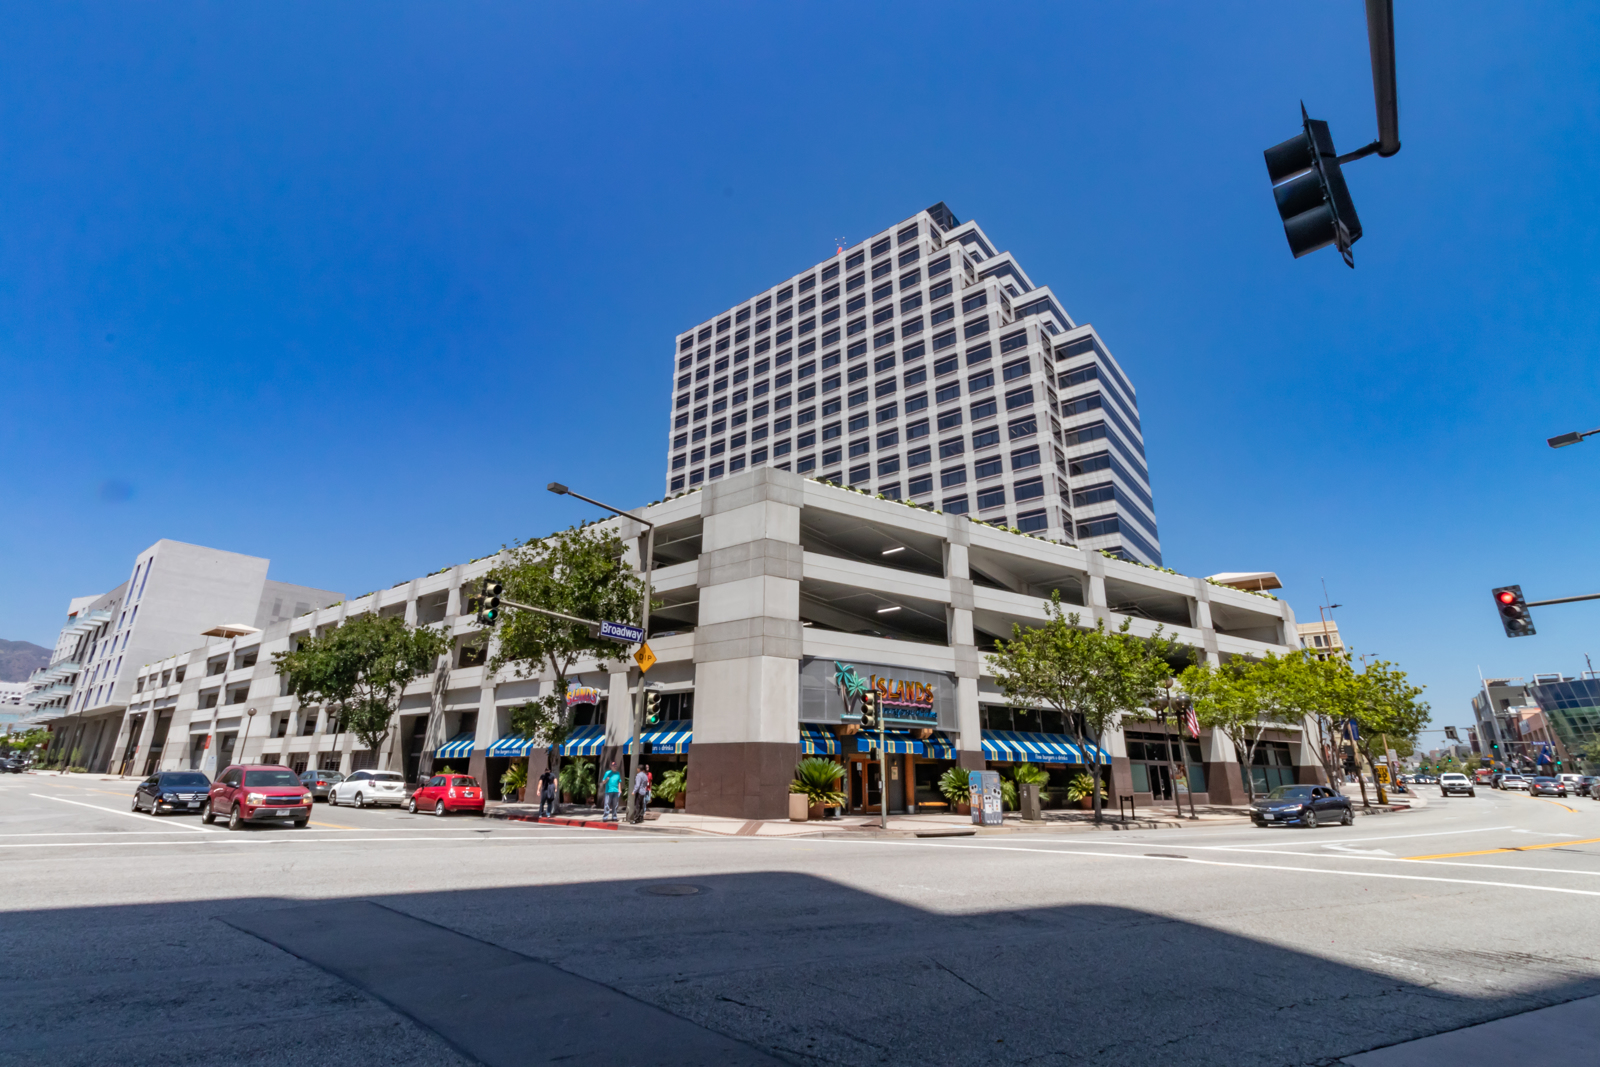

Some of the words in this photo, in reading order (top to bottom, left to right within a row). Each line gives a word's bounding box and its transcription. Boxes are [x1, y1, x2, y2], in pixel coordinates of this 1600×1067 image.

[602, 622, 642, 641] Broadway
[638, 653, 652, 661] DIP
[870, 674, 934, 703] ISLANDS
